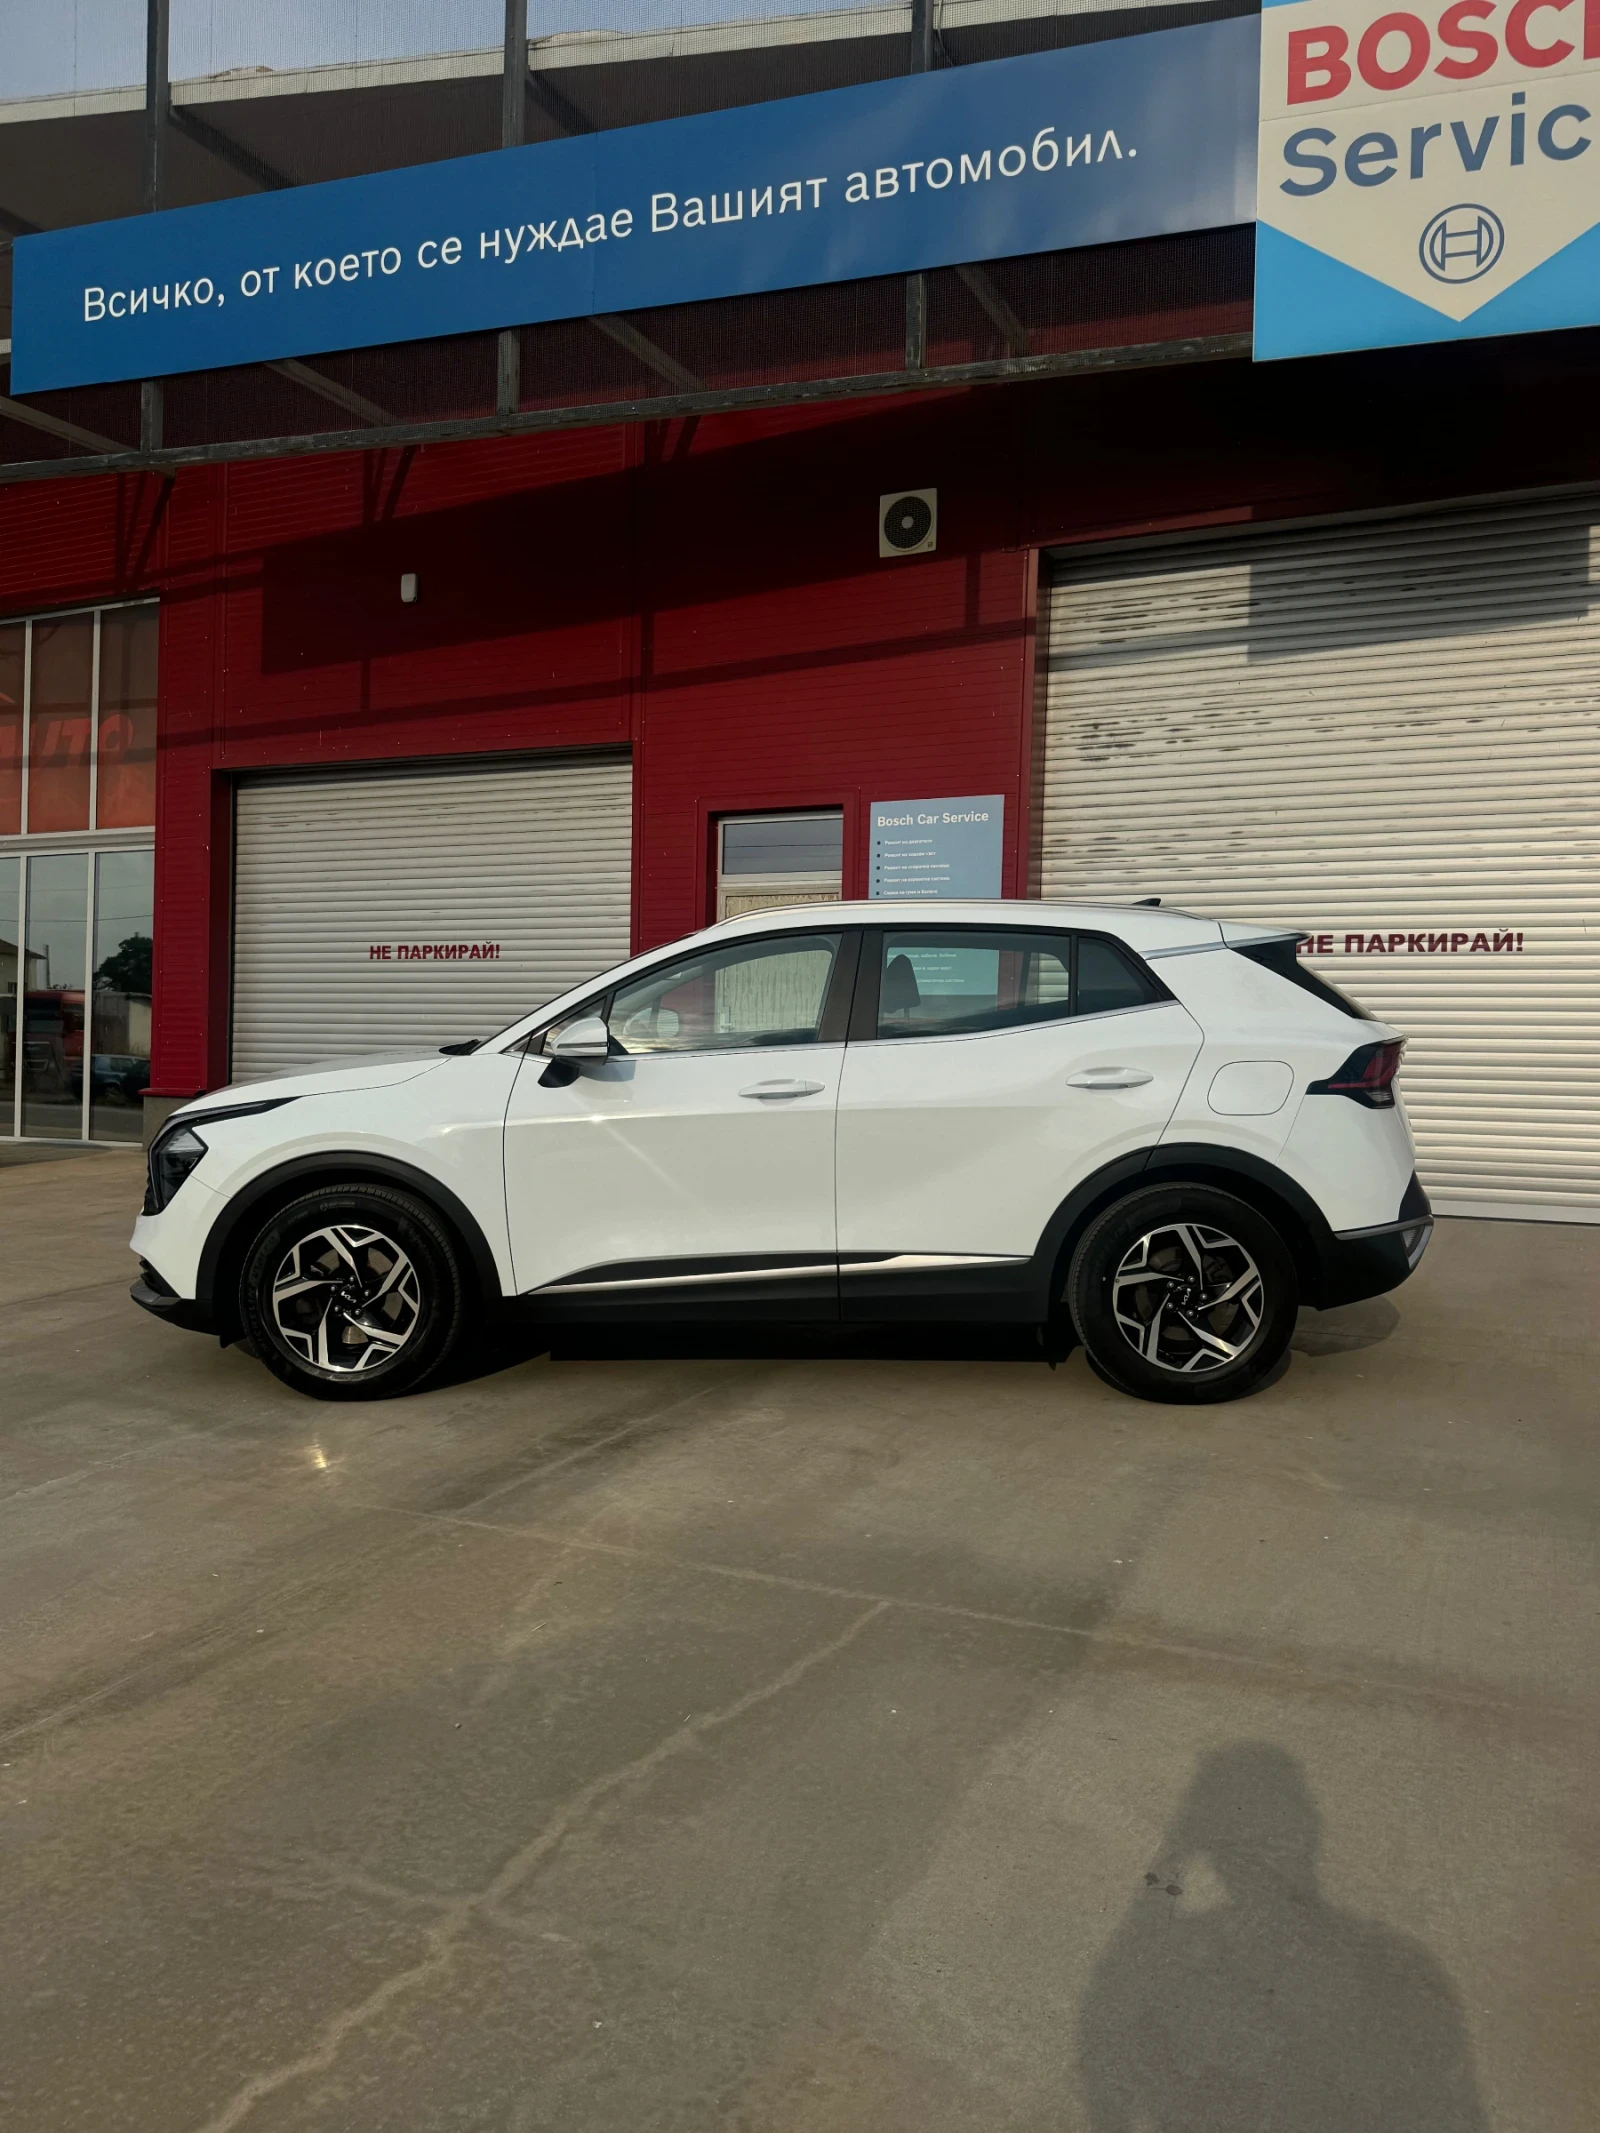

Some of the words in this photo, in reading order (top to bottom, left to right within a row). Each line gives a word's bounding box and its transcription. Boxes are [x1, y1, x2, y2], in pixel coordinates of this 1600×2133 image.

[84, 278, 225, 322] Всичко,
[240, 267, 280, 297] от
[294, 247, 402, 290] което
[417, 237, 462, 268] се
[480, 208, 633, 265] нуждае
[651, 177, 828, 233] Вашият
[845, 126, 1137, 203] автомобил.
[877, 814, 914, 827] Bosch
[917, 813, 939, 825] Car
[942, 811, 989, 824] Service
[369, 945, 392, 960] НЕ
[397, 941, 500, 960] ПАРКИРАЙ!
[1295, 934, 1334, 953] НЕ
[1344, 928, 1524, 953] ПАРКИРАЙ!
